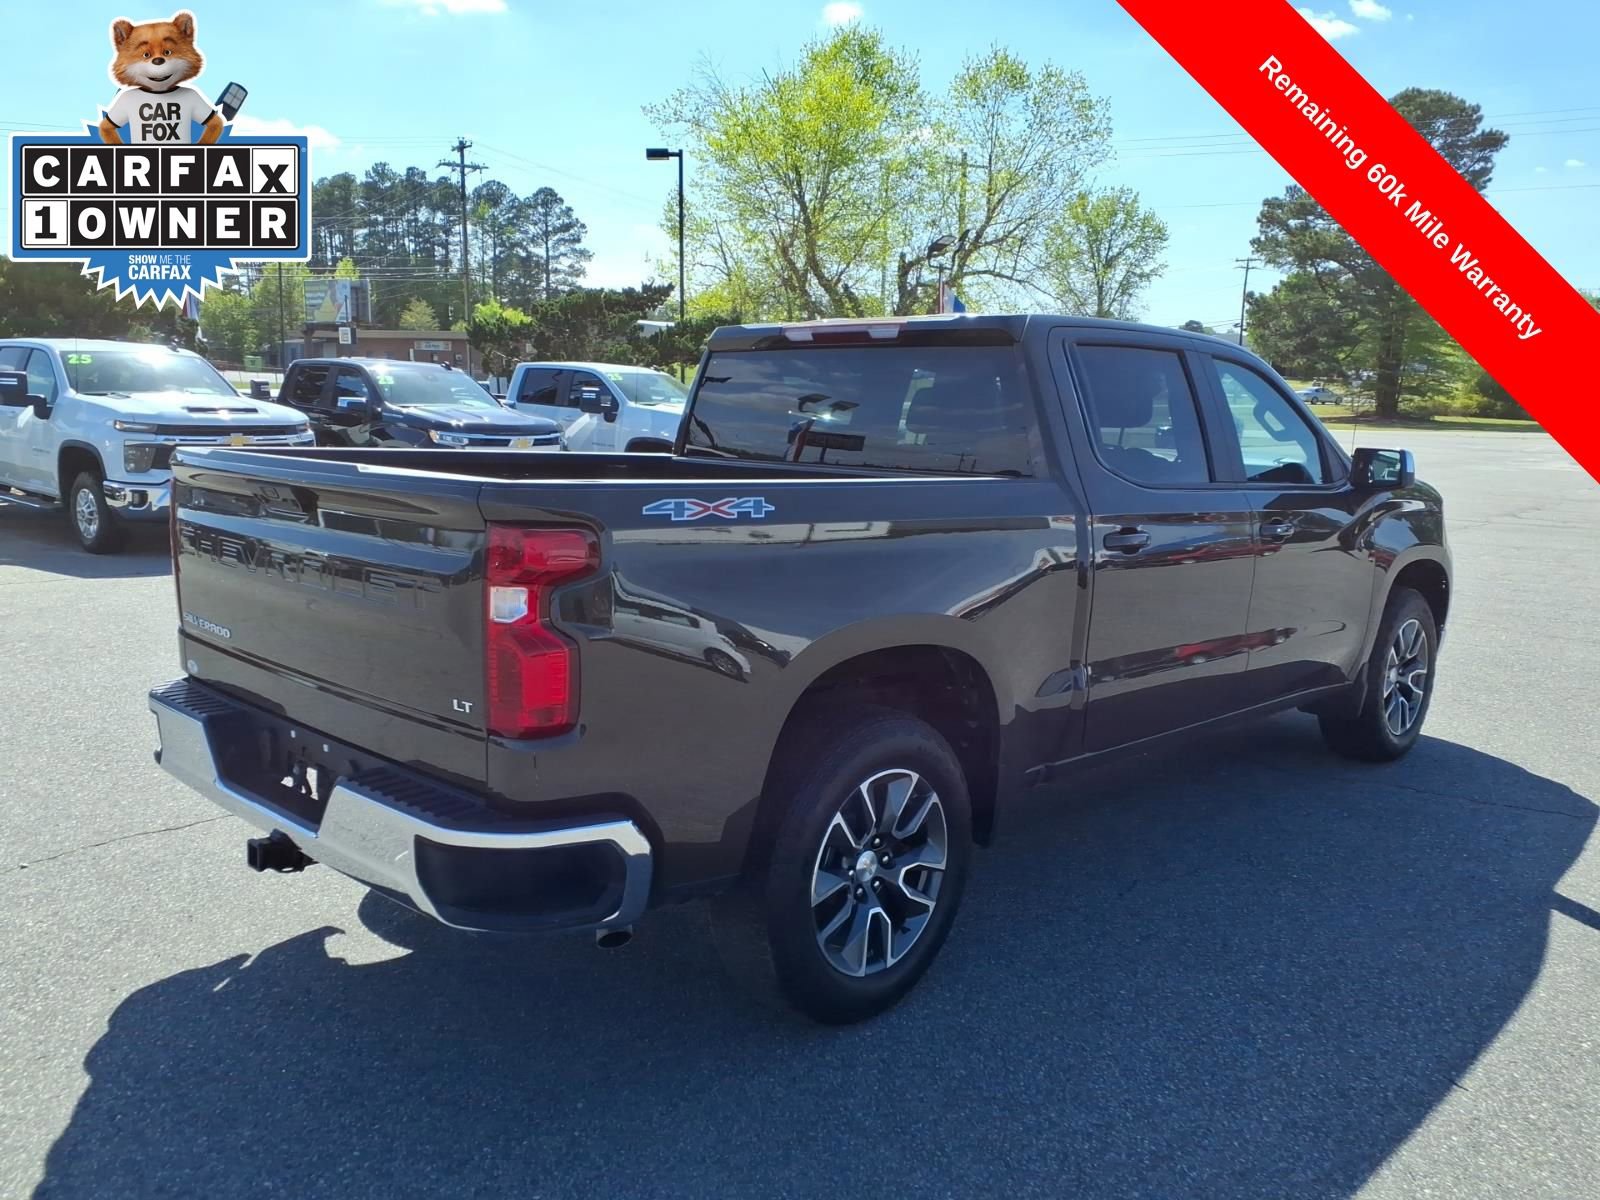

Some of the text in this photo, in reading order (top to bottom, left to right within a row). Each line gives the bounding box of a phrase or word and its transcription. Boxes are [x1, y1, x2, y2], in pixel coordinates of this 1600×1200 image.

[67, 354, 92, 364] 25
[184, 612, 231, 639] SILVERADO
[452, 699, 473, 713] LT
